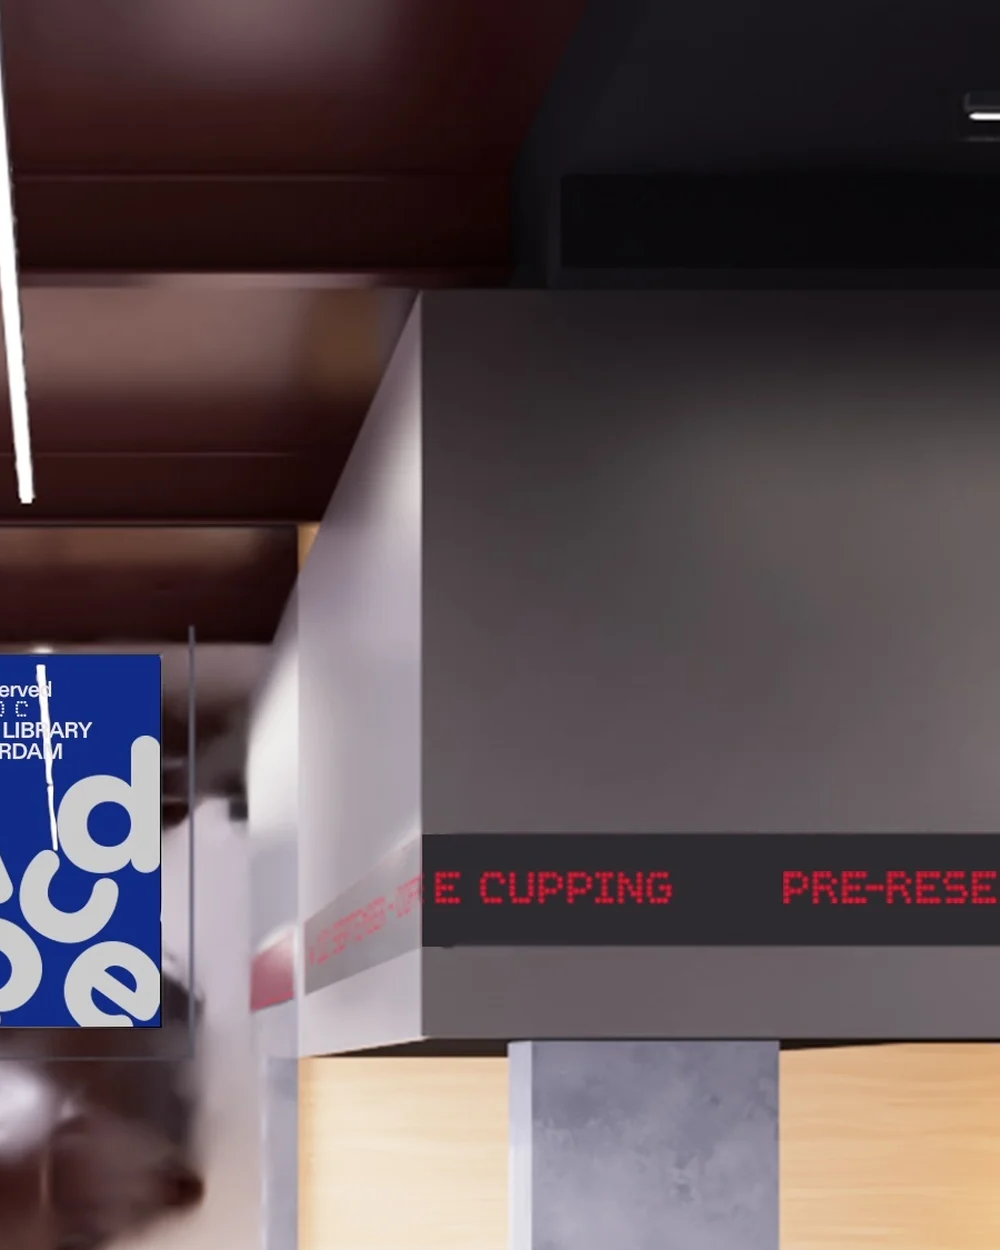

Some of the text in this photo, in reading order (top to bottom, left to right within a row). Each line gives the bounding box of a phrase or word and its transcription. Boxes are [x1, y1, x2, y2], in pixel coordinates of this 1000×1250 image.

[3, 721, 93, 739] LIBRARY
[14, 700, 29, 718] C
[56, 735, 160, 873] d
[19, 849, 119, 944] c
[479, 870, 673, 904] CUPPING
[782, 870, 998, 904] PRE-RESE
[64, 940, 160, 1028] e
